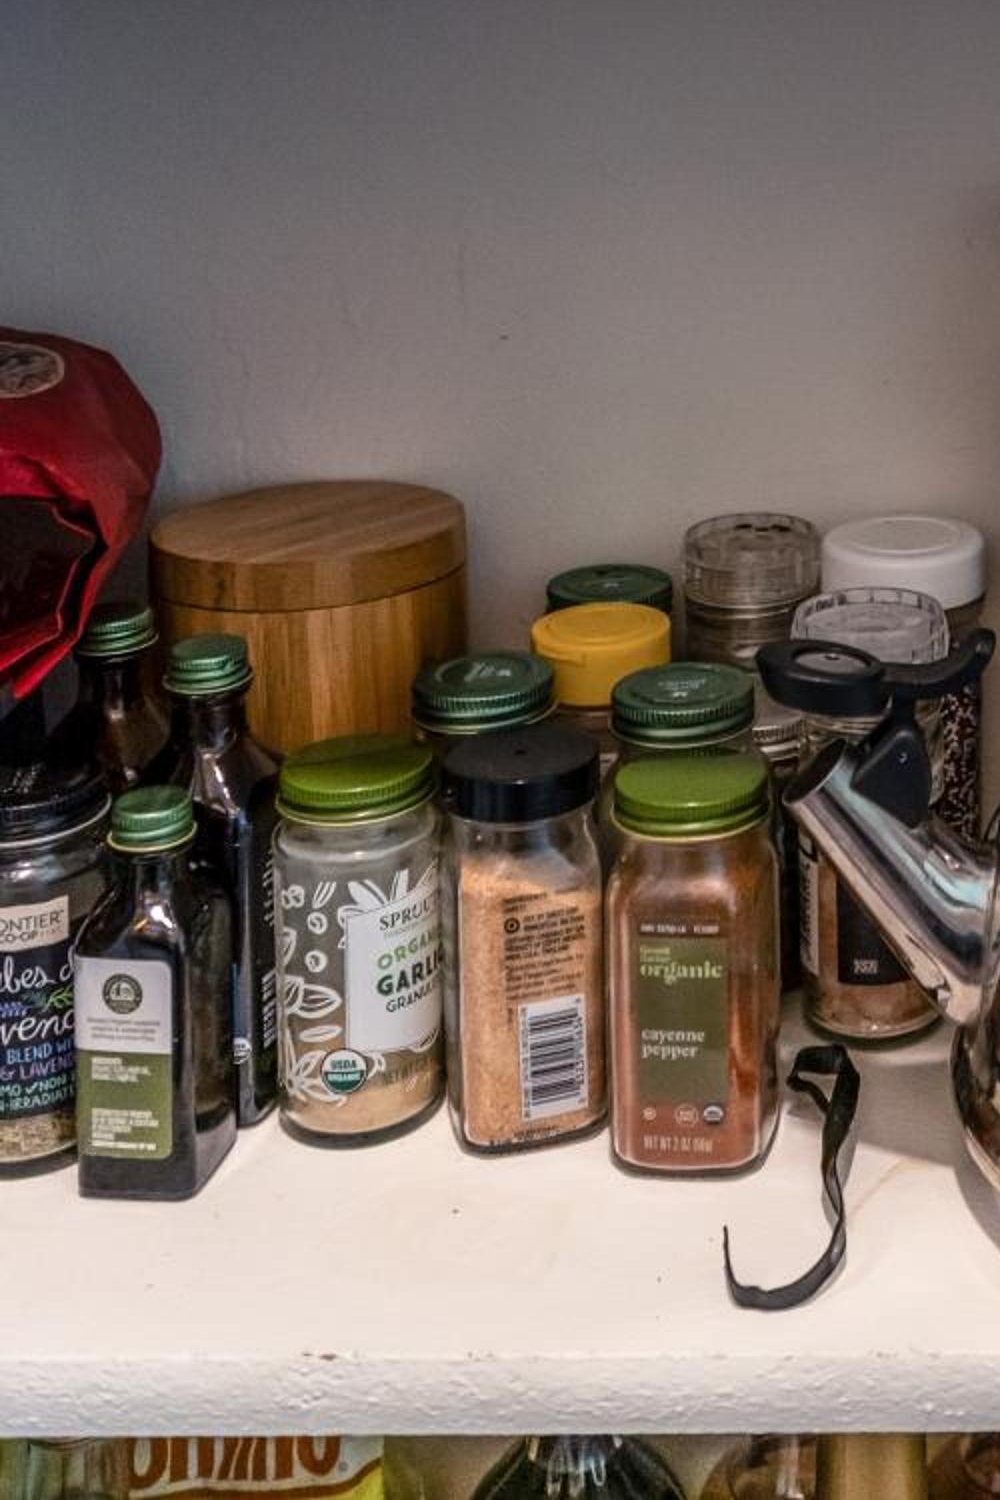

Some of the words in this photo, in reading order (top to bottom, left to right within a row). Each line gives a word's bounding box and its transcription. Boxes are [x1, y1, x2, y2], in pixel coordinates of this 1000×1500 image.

[640, 960, 724, 987] organic
[641, 1029, 706, 1045] cayenne
[6, 1041, 53, 1065] BLEND
[641, 1044, 700, 1061] pepper
[330, 1059, 358, 1071] USDA
